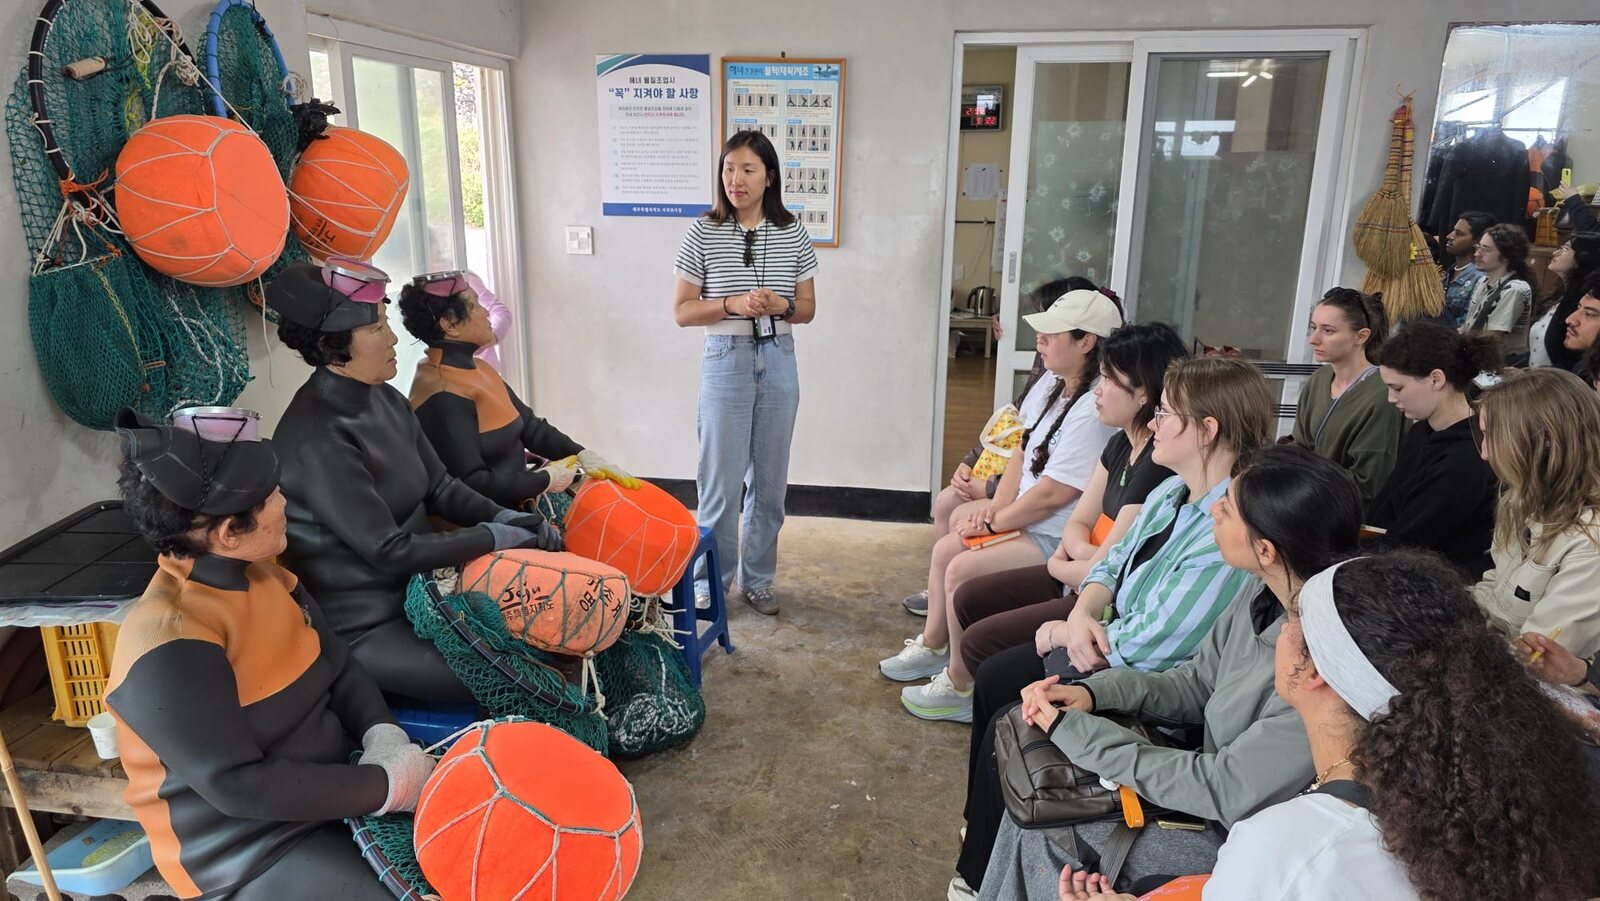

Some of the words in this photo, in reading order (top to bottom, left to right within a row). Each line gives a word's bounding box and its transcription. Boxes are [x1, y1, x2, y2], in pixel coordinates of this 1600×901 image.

[629, 76, 642, 84] 해녀
[644, 76, 676, 85] 물질조업시
[633, 87, 663, 99] 지켜야
[666, 87, 676, 99] 할
[679, 87, 699, 99] 사항
